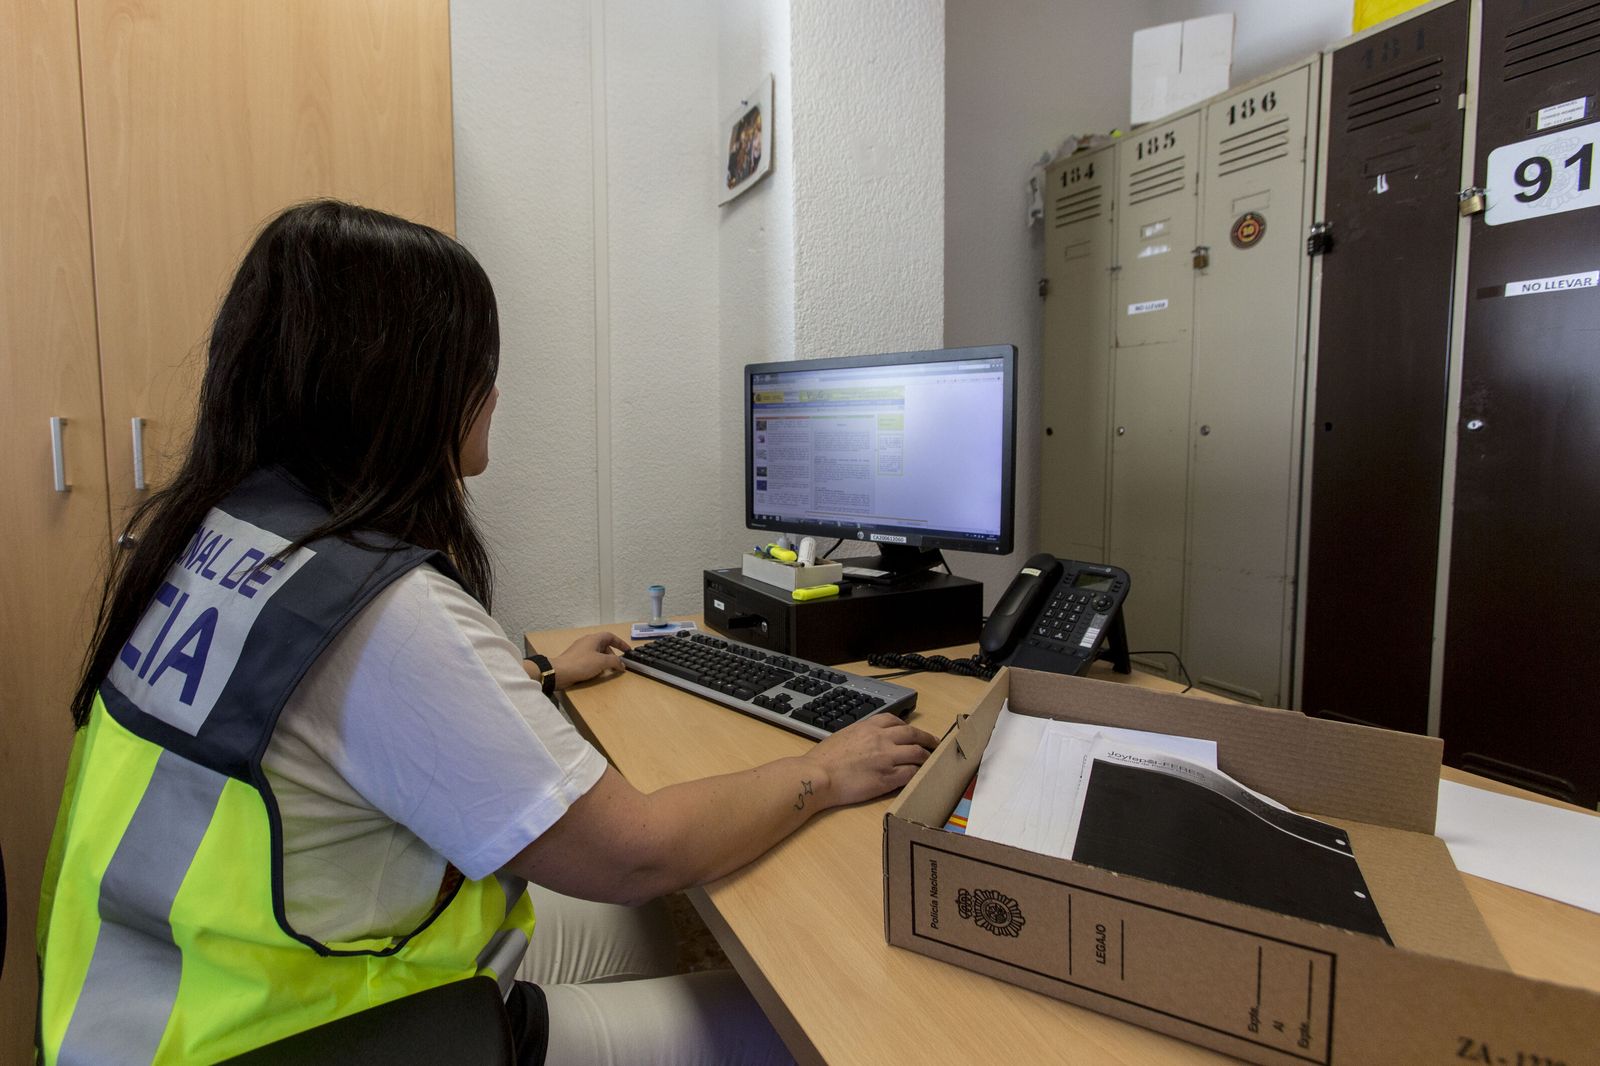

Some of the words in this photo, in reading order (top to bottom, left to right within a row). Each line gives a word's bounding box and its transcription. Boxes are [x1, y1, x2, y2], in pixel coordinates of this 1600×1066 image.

[1226, 91, 1278, 126] 186
[1136, 131, 1176, 160] 185
[1060, 162, 1095, 187] 184
[1514, 142, 1594, 203] 91
[1521, 280, 1541, 292] NO
[1544, 277, 1592, 290] LLEVAR
[176, 526, 233, 580] NAL
[219, 547, 286, 599] DE
[928, 859, 938, 898] Nacional
[930, 898, 939, 930] Policía
[1096, 924, 1106, 965] LEGAJO
